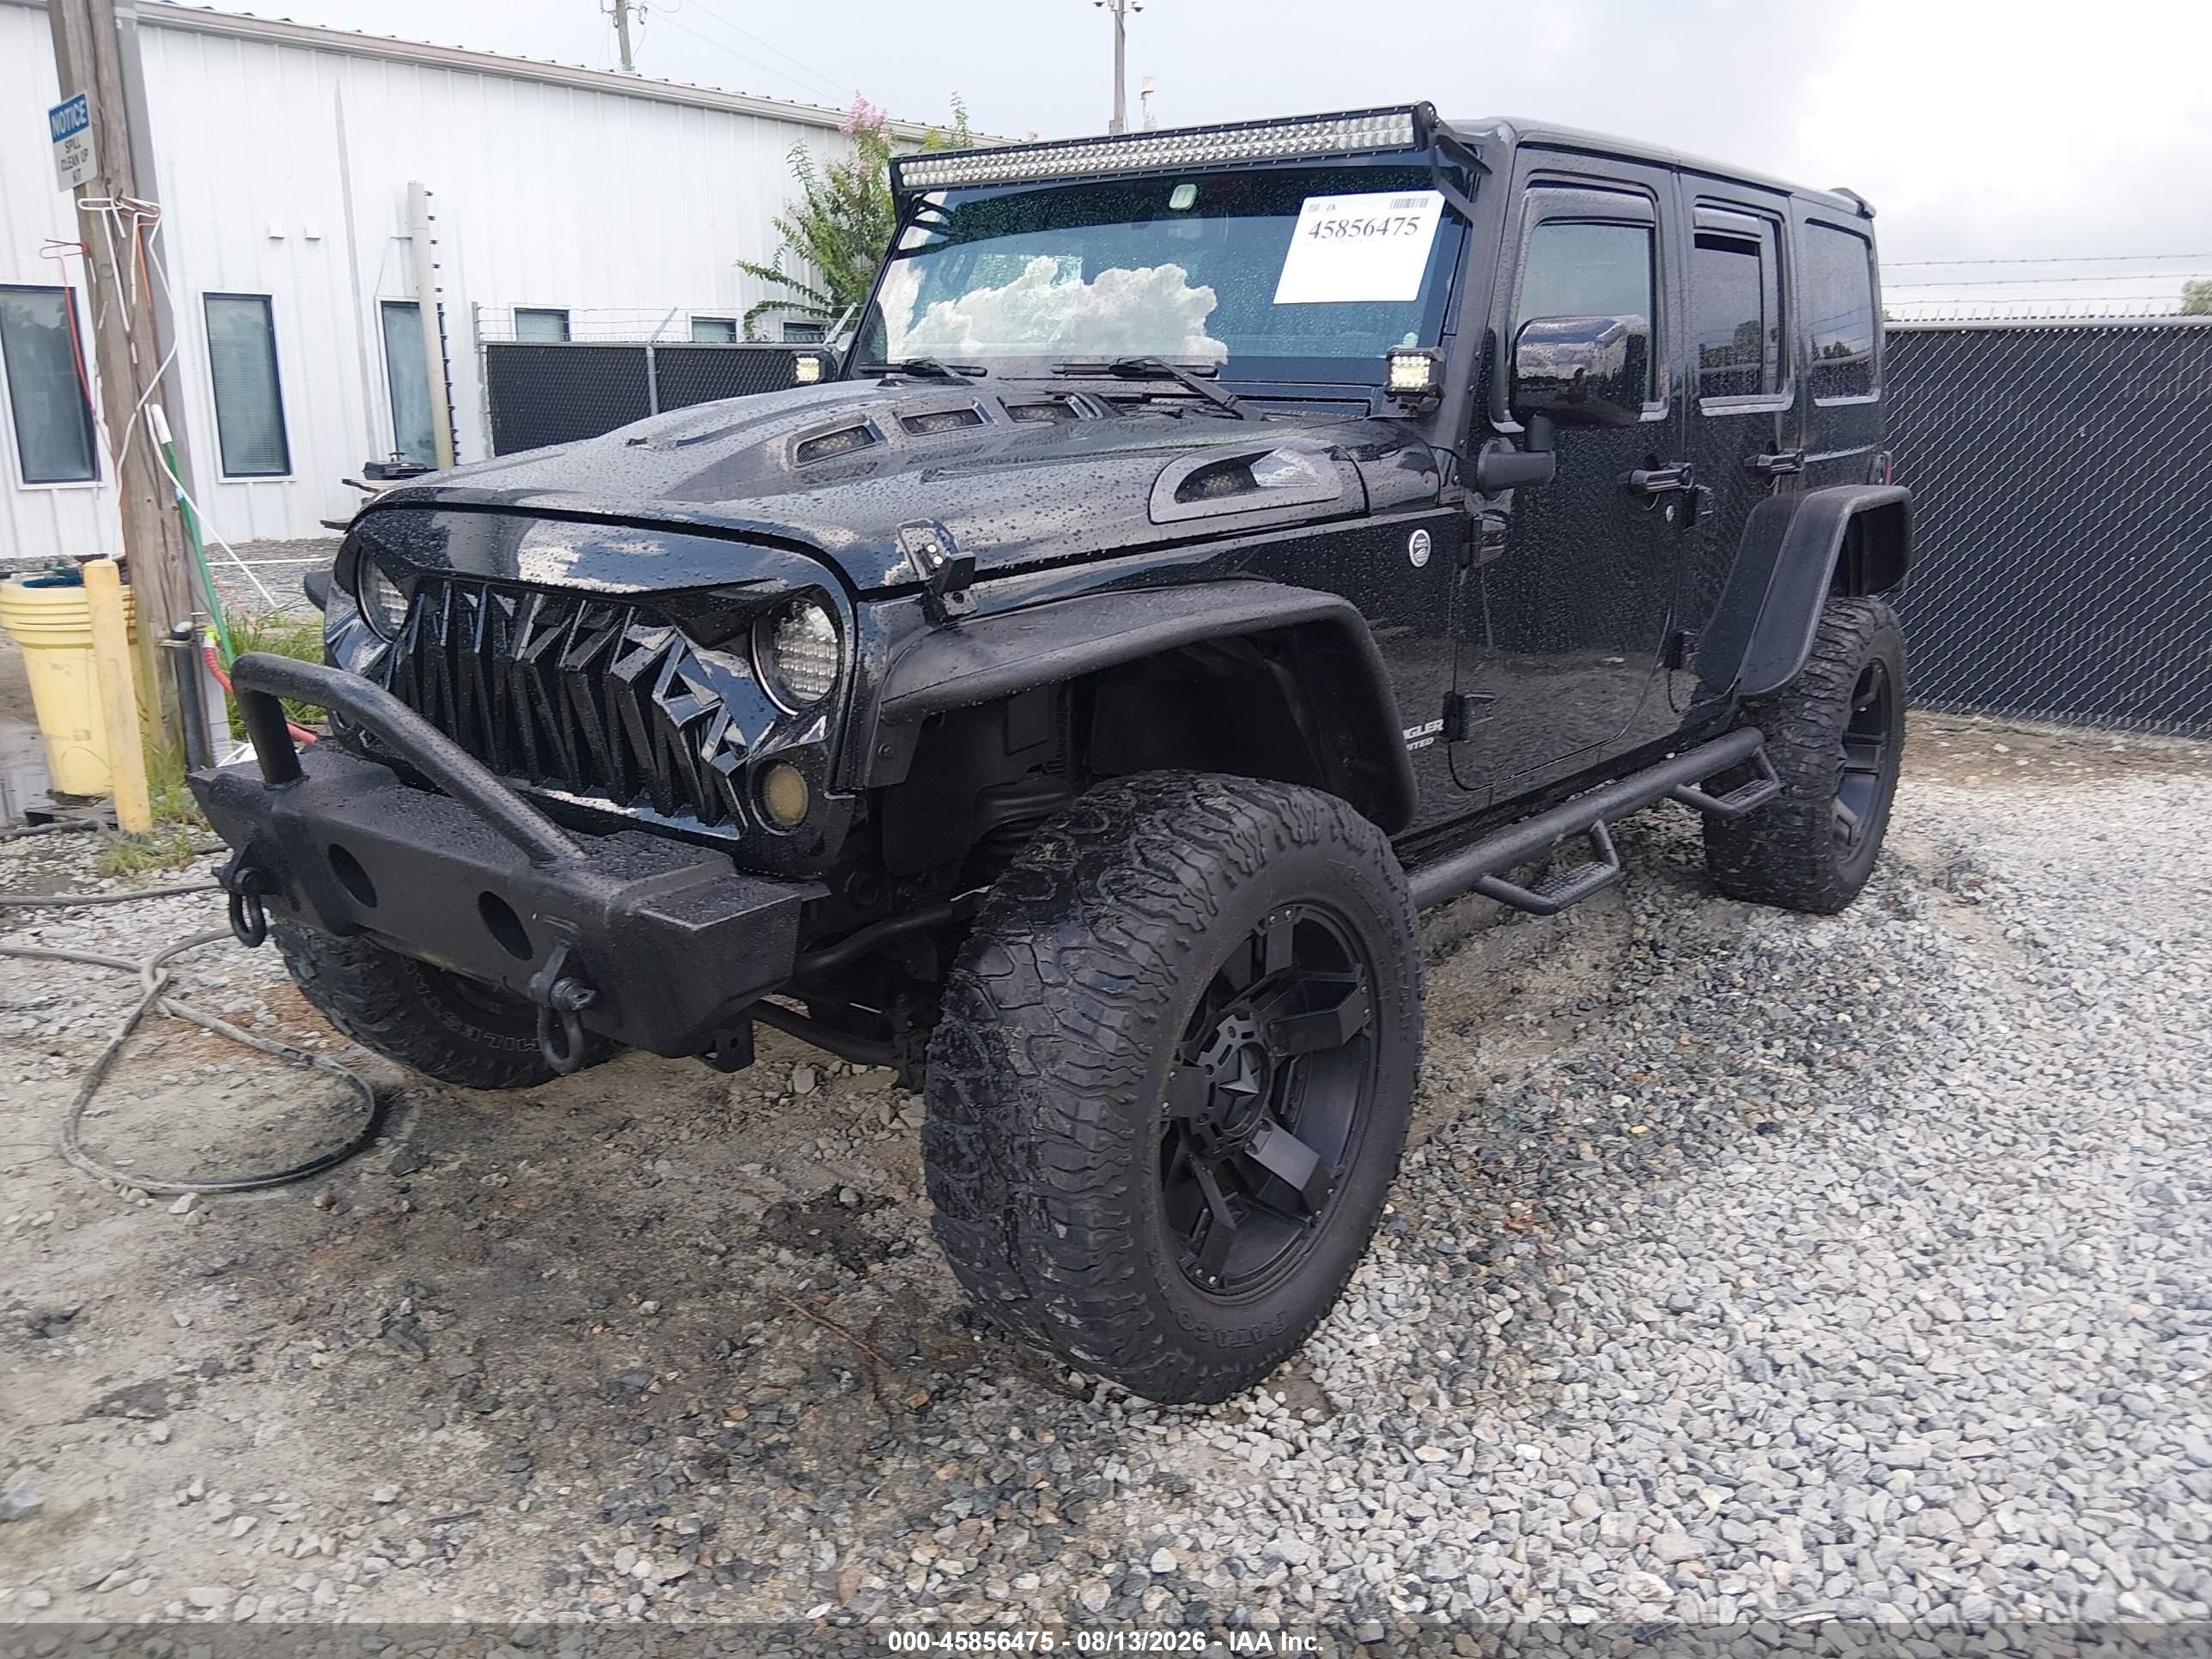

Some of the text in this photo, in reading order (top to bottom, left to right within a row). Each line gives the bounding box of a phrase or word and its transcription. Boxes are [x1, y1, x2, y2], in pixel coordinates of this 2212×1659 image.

[51, 100, 88, 137] NOTICE
[64, 137, 82, 154] SPILL
[61, 148, 89, 173] CLEAN UP
[72, 168, 82, 182] KIT
[1309, 216, 1421, 239] 45856475
